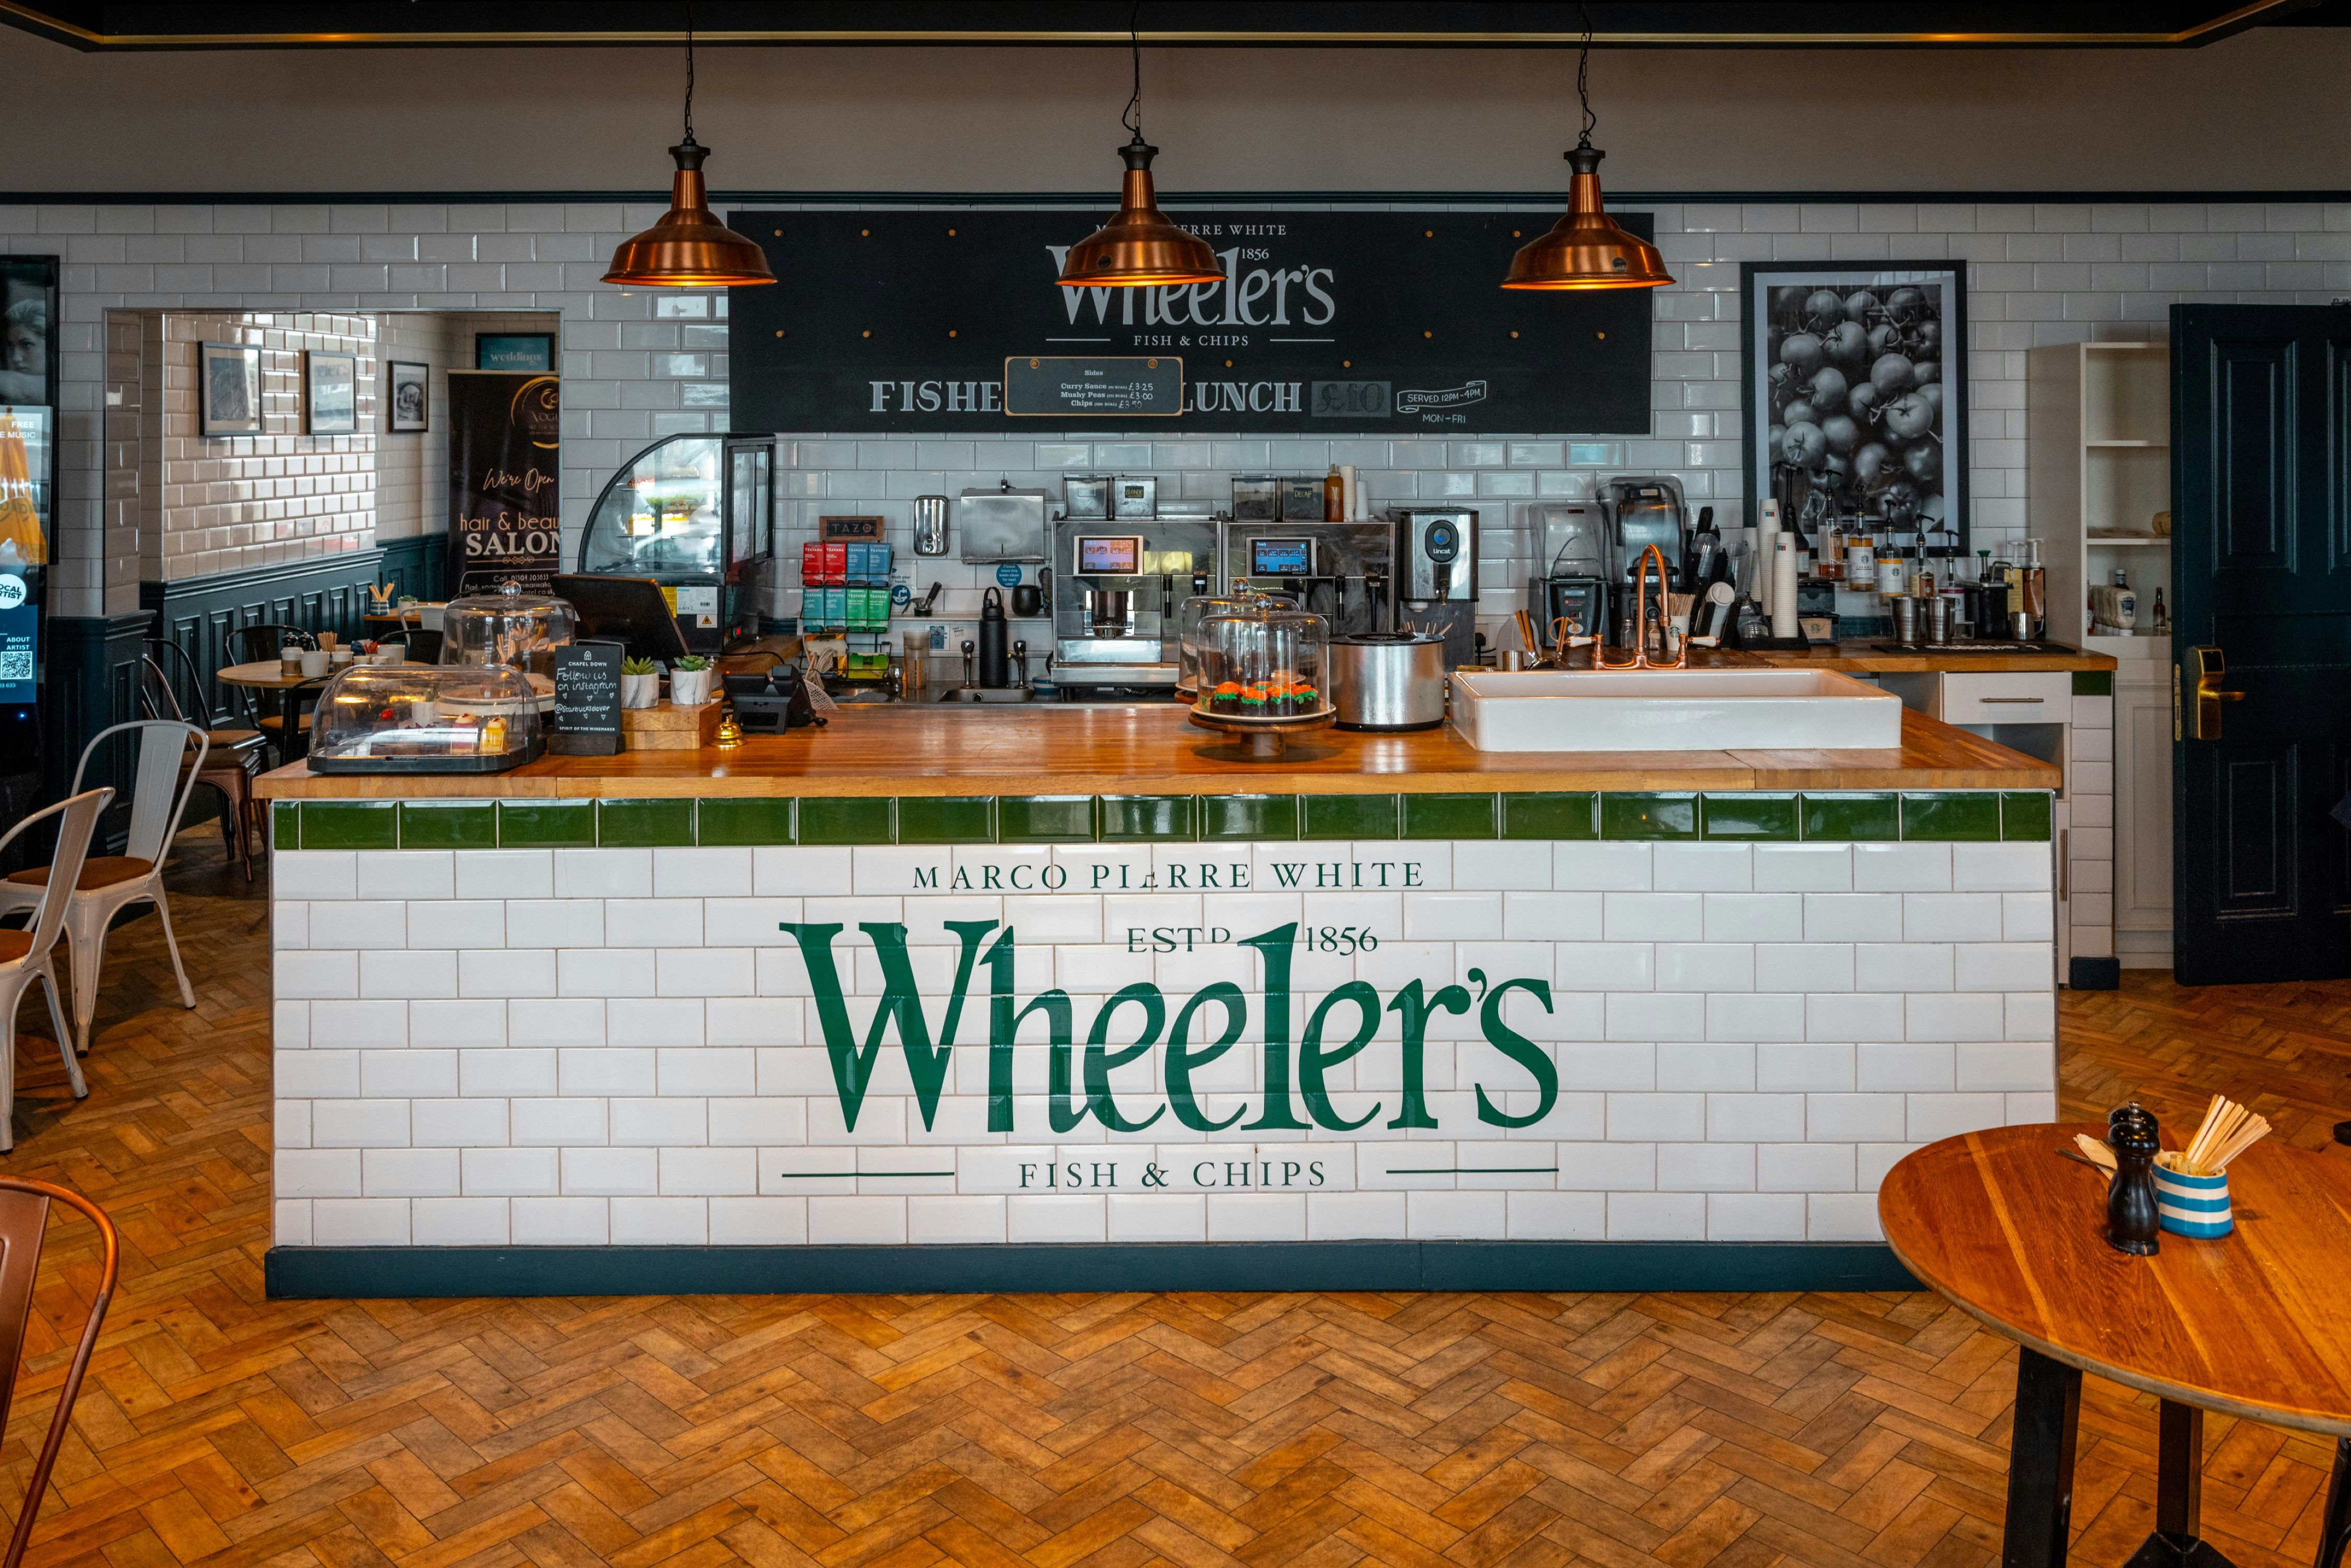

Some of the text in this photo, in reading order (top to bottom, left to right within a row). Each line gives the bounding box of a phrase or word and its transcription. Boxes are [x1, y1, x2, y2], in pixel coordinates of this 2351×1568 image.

[1173, 225, 1287, 235] ERRE WHITE
[1242, 248, 1269, 260] 1856
[1134, 335, 1249, 346] FISH & CHIPS
[869, 381, 1005, 412] FISHE
[1407, 394, 1439, 403] SERVED
[483, 468, 554, 493] We're Open
[460, 512, 490, 531] hair
[498, 512, 510, 531] &
[832, 523, 872, 533] TAZO
[466, 531, 559, 556] SALON
[557, 667, 607, 681] Follow us
[572, 681, 617, 694] instagram
[913, 864, 1067, 889] MARCO
[1271, 862, 1423, 887] WHITE
[1306, 926, 1379, 955] 1856
[779, 919, 1559, 1133] Wheeler's
[1019, 1161, 1327, 1190] FISH & CHIPS
